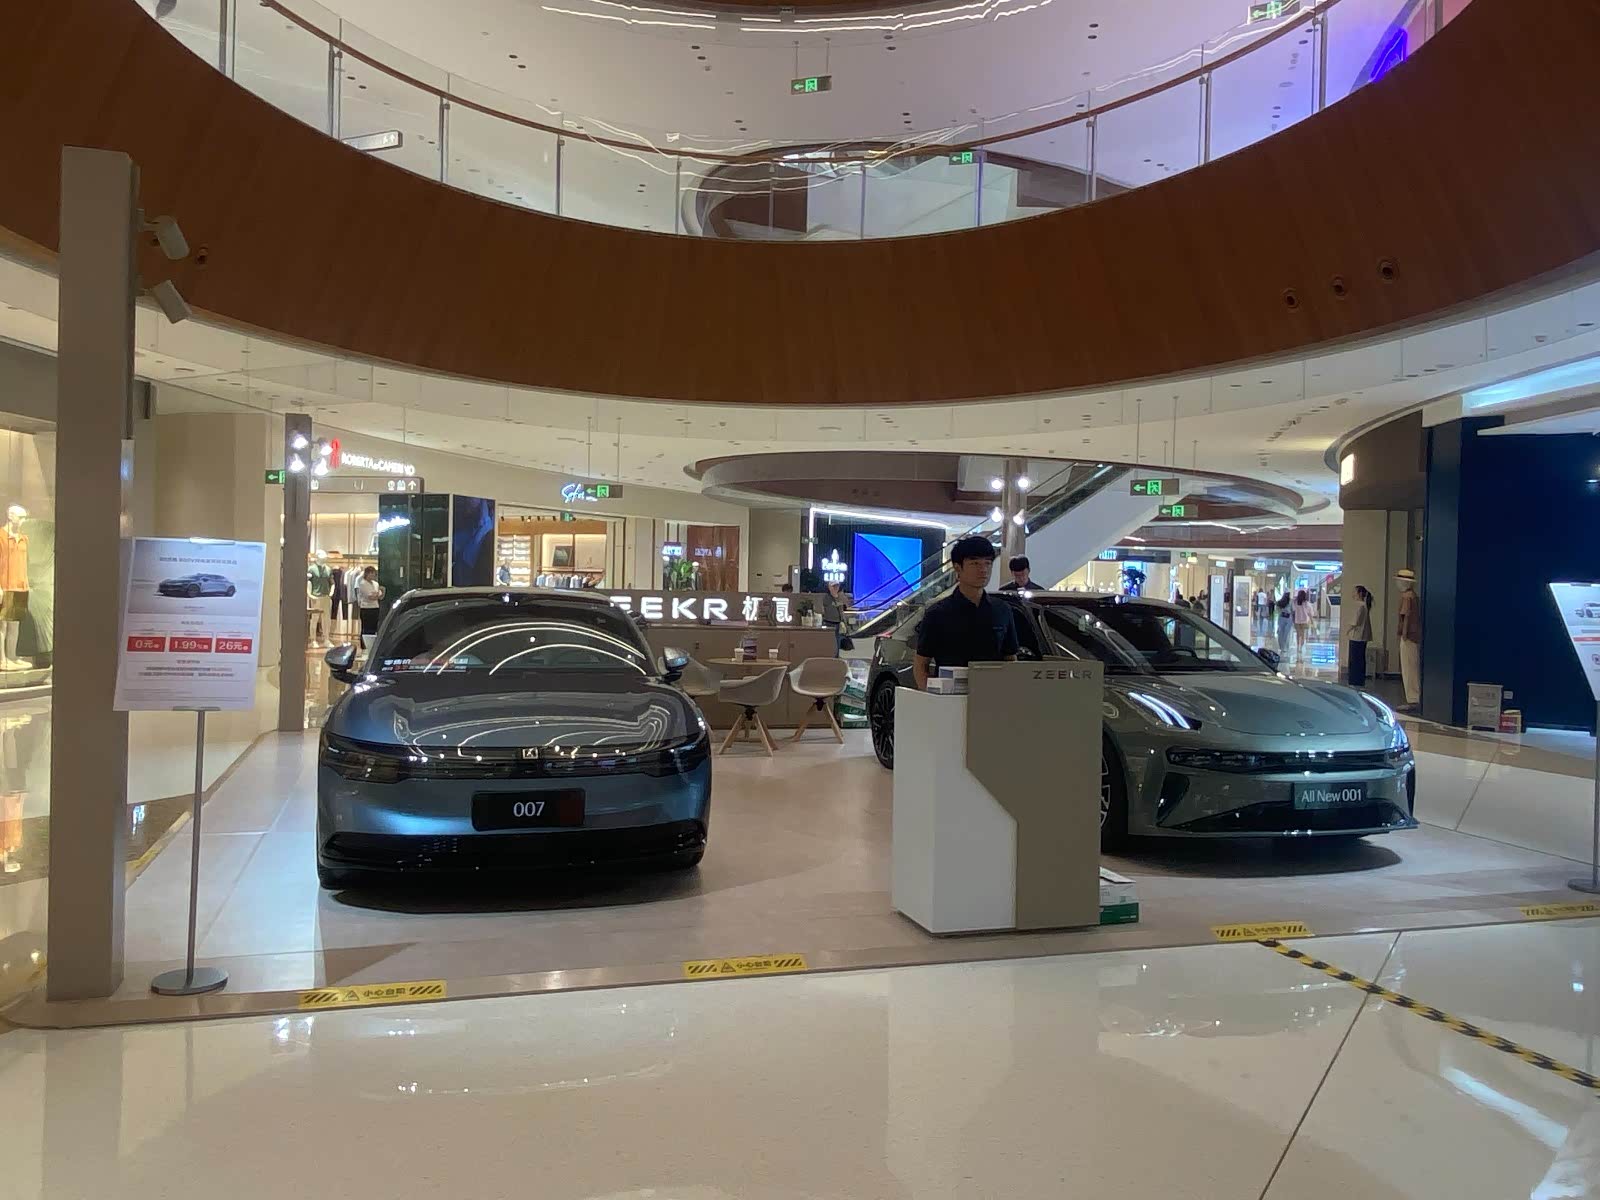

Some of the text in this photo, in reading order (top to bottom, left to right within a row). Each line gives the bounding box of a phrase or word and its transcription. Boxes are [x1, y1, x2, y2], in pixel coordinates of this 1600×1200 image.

[609, 595, 729, 620] EEKR
[1301, 788, 1362, 803] All New 001
[513, 801, 545, 818] 007
